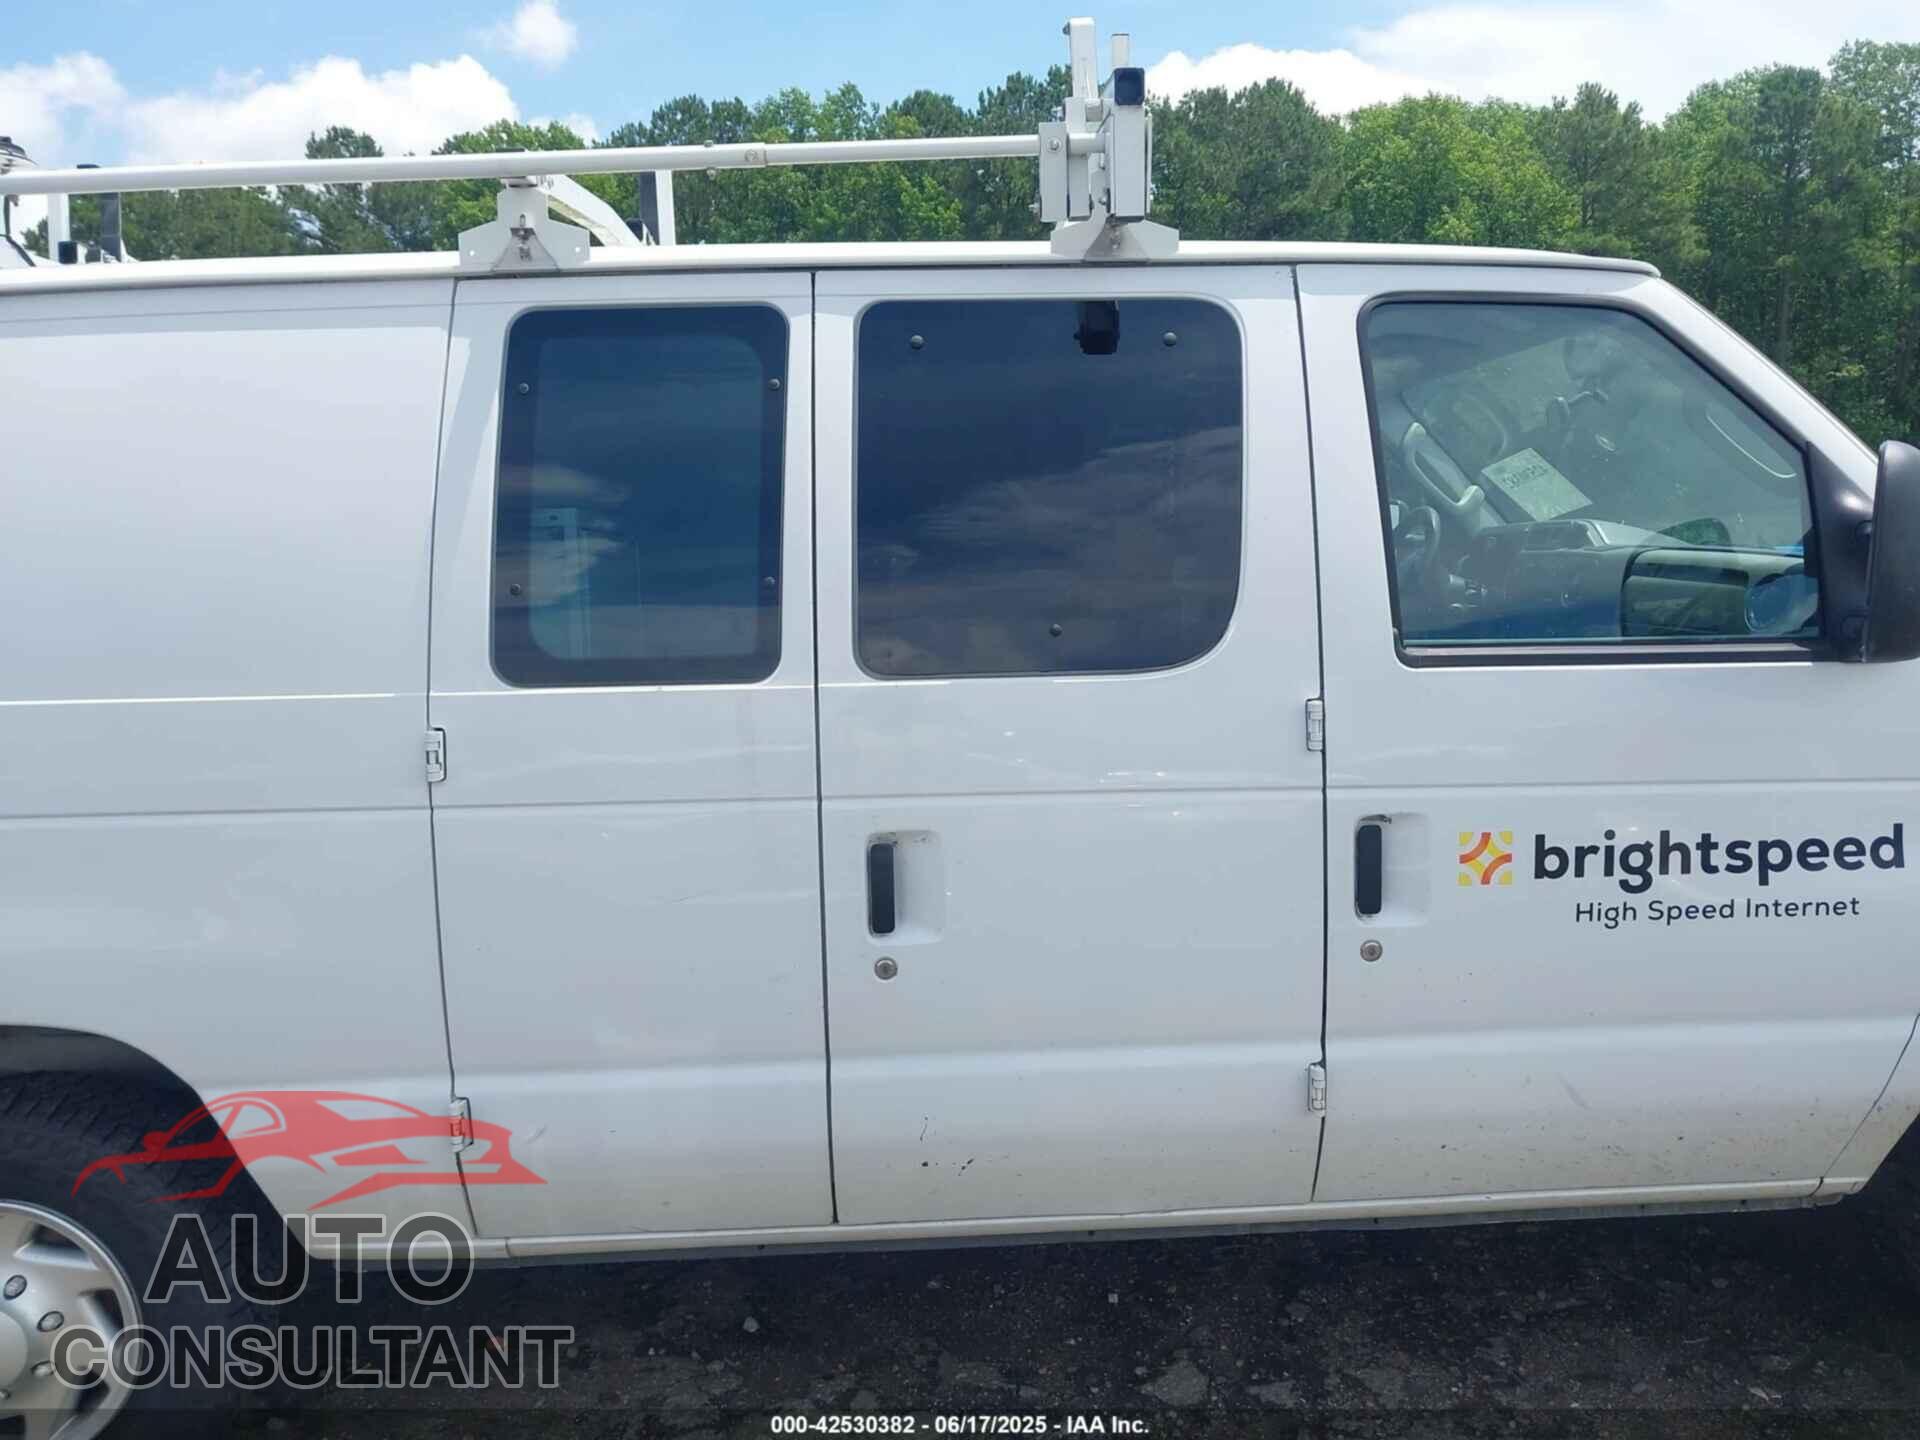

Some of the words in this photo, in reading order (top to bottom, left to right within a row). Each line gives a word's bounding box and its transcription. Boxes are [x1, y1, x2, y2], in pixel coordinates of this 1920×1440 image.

[1534, 823, 1906, 894] brightspeed
[1575, 901, 1638, 930] High
[1647, 898, 1736, 926] Speed
[1745, 896, 1861, 919] Internet
